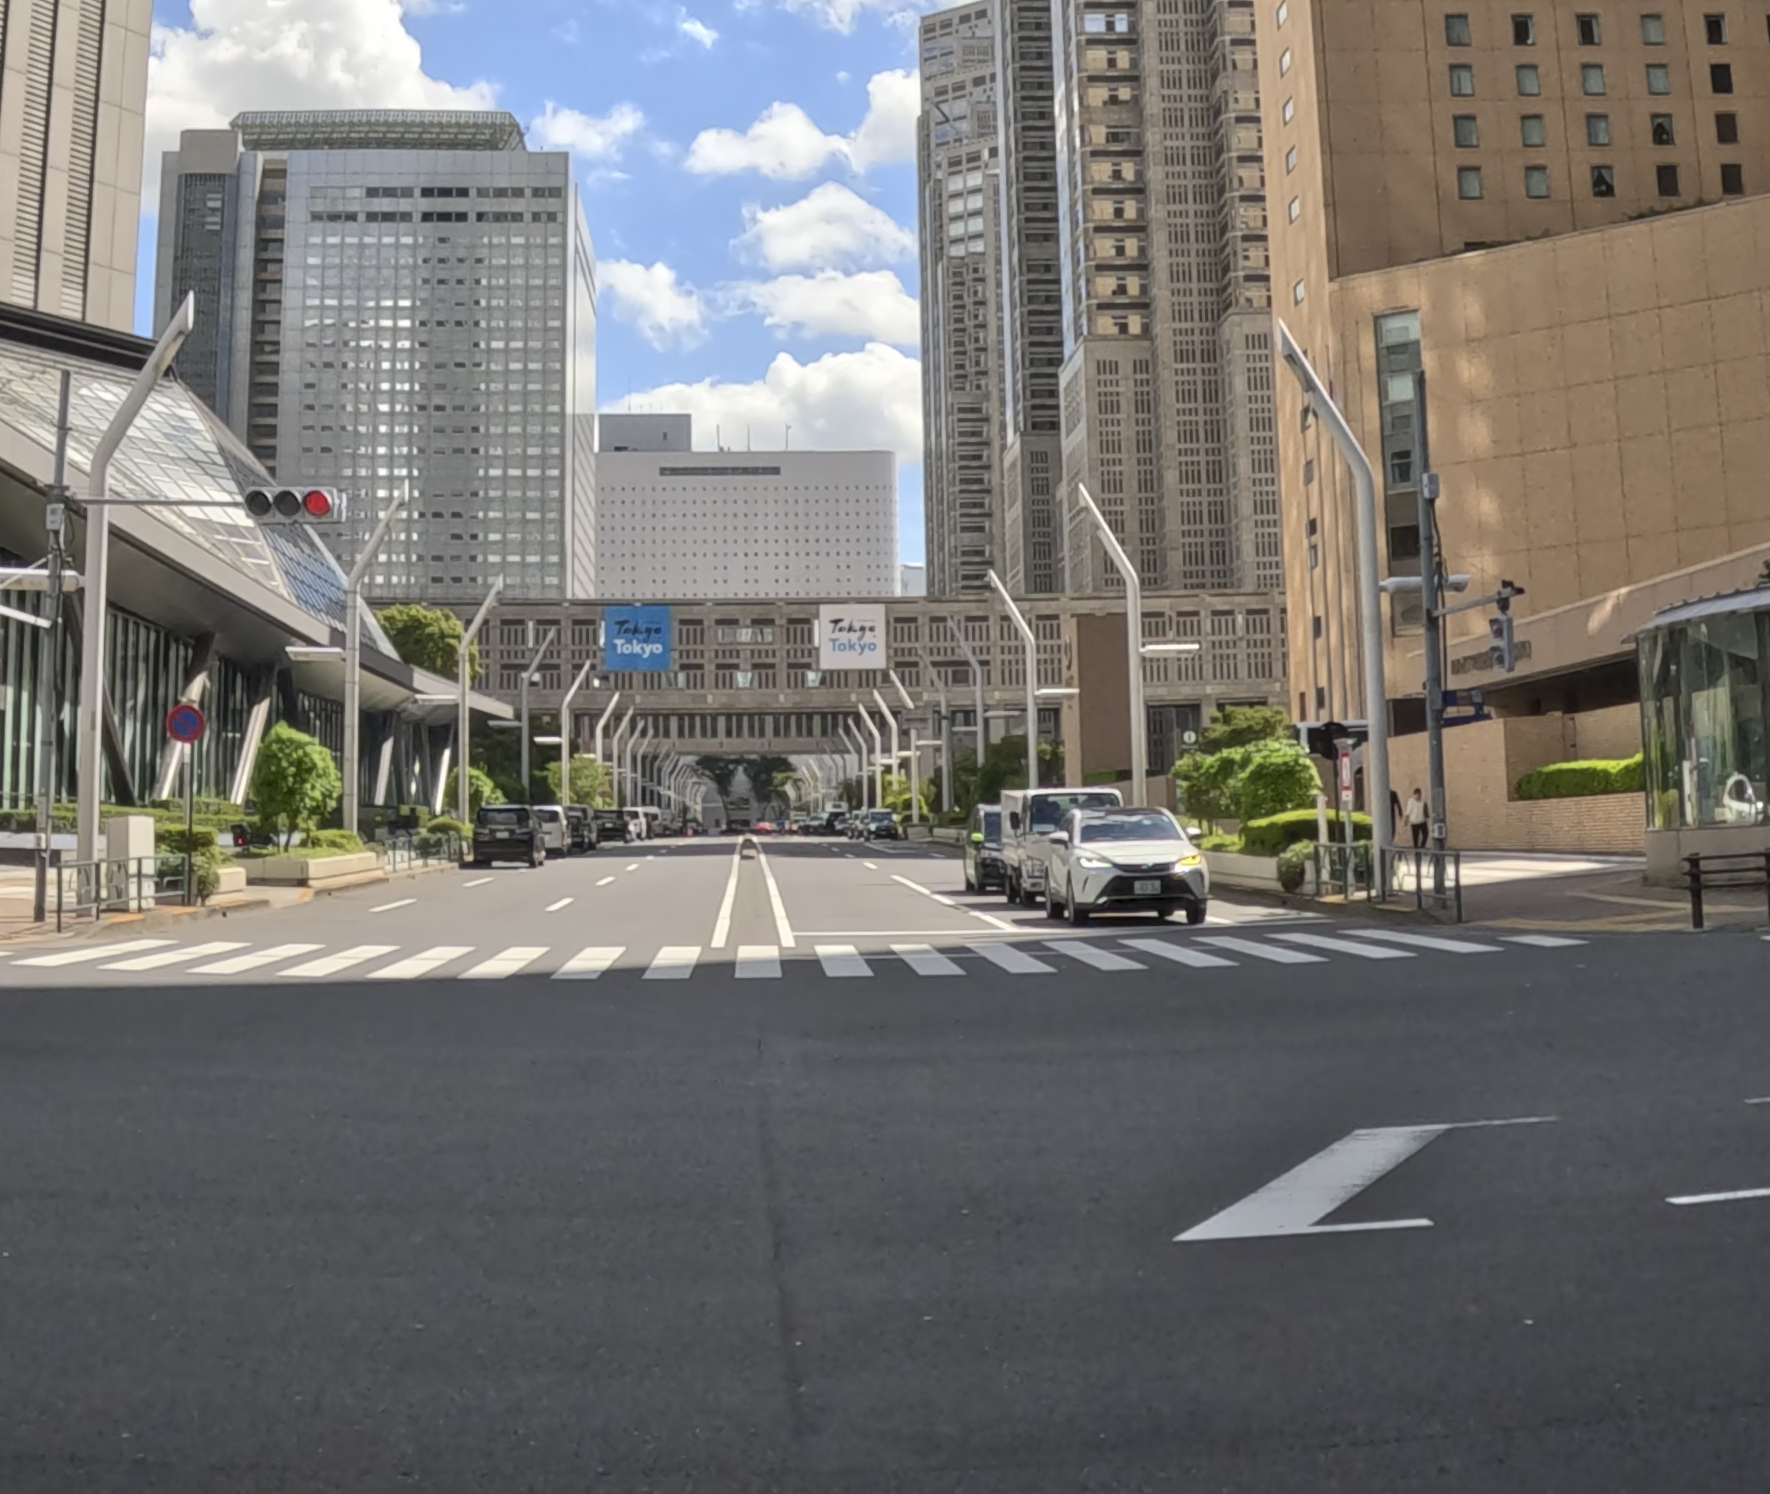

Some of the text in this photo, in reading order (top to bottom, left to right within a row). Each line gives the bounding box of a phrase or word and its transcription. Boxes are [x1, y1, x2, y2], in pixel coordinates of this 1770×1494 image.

[614, 619, 662, 643] Tokyo
[828, 618, 876, 641] Tokyo
[613, 638, 663, 658] Tokyo
[829, 638, 877, 656] Tokyo
